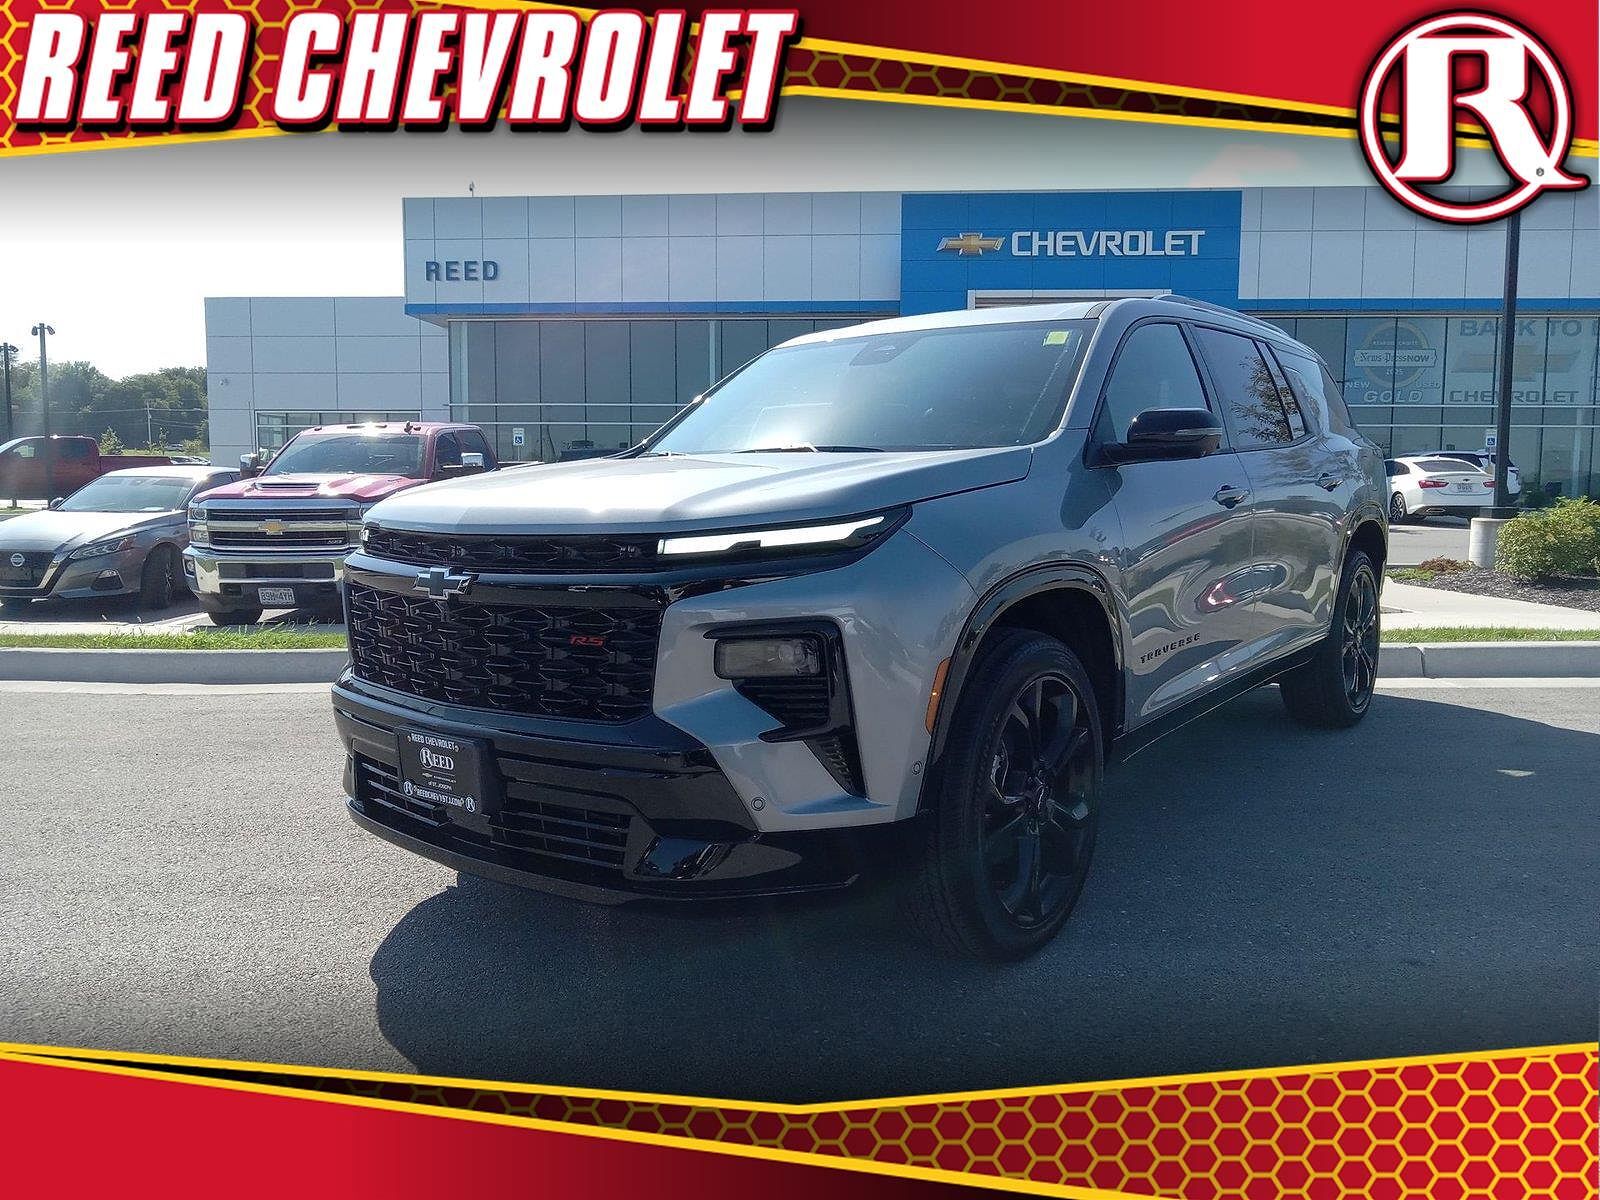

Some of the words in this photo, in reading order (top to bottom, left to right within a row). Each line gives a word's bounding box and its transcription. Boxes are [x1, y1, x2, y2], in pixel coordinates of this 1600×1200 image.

[1011, 230, 1206, 256] CHEVROLET
[425, 261, 498, 281] REED
[1547, 319, 1582, 336] TO
[1364, 390, 1423, 402] GOLD
[1449, 390, 1579, 402] CHEROLET
[570, 636, 604, 646] RS
[1140, 632, 1200, 664] TRAVERSE
[411, 733, 425, 744] REED
[420, 747, 454, 770] REED
